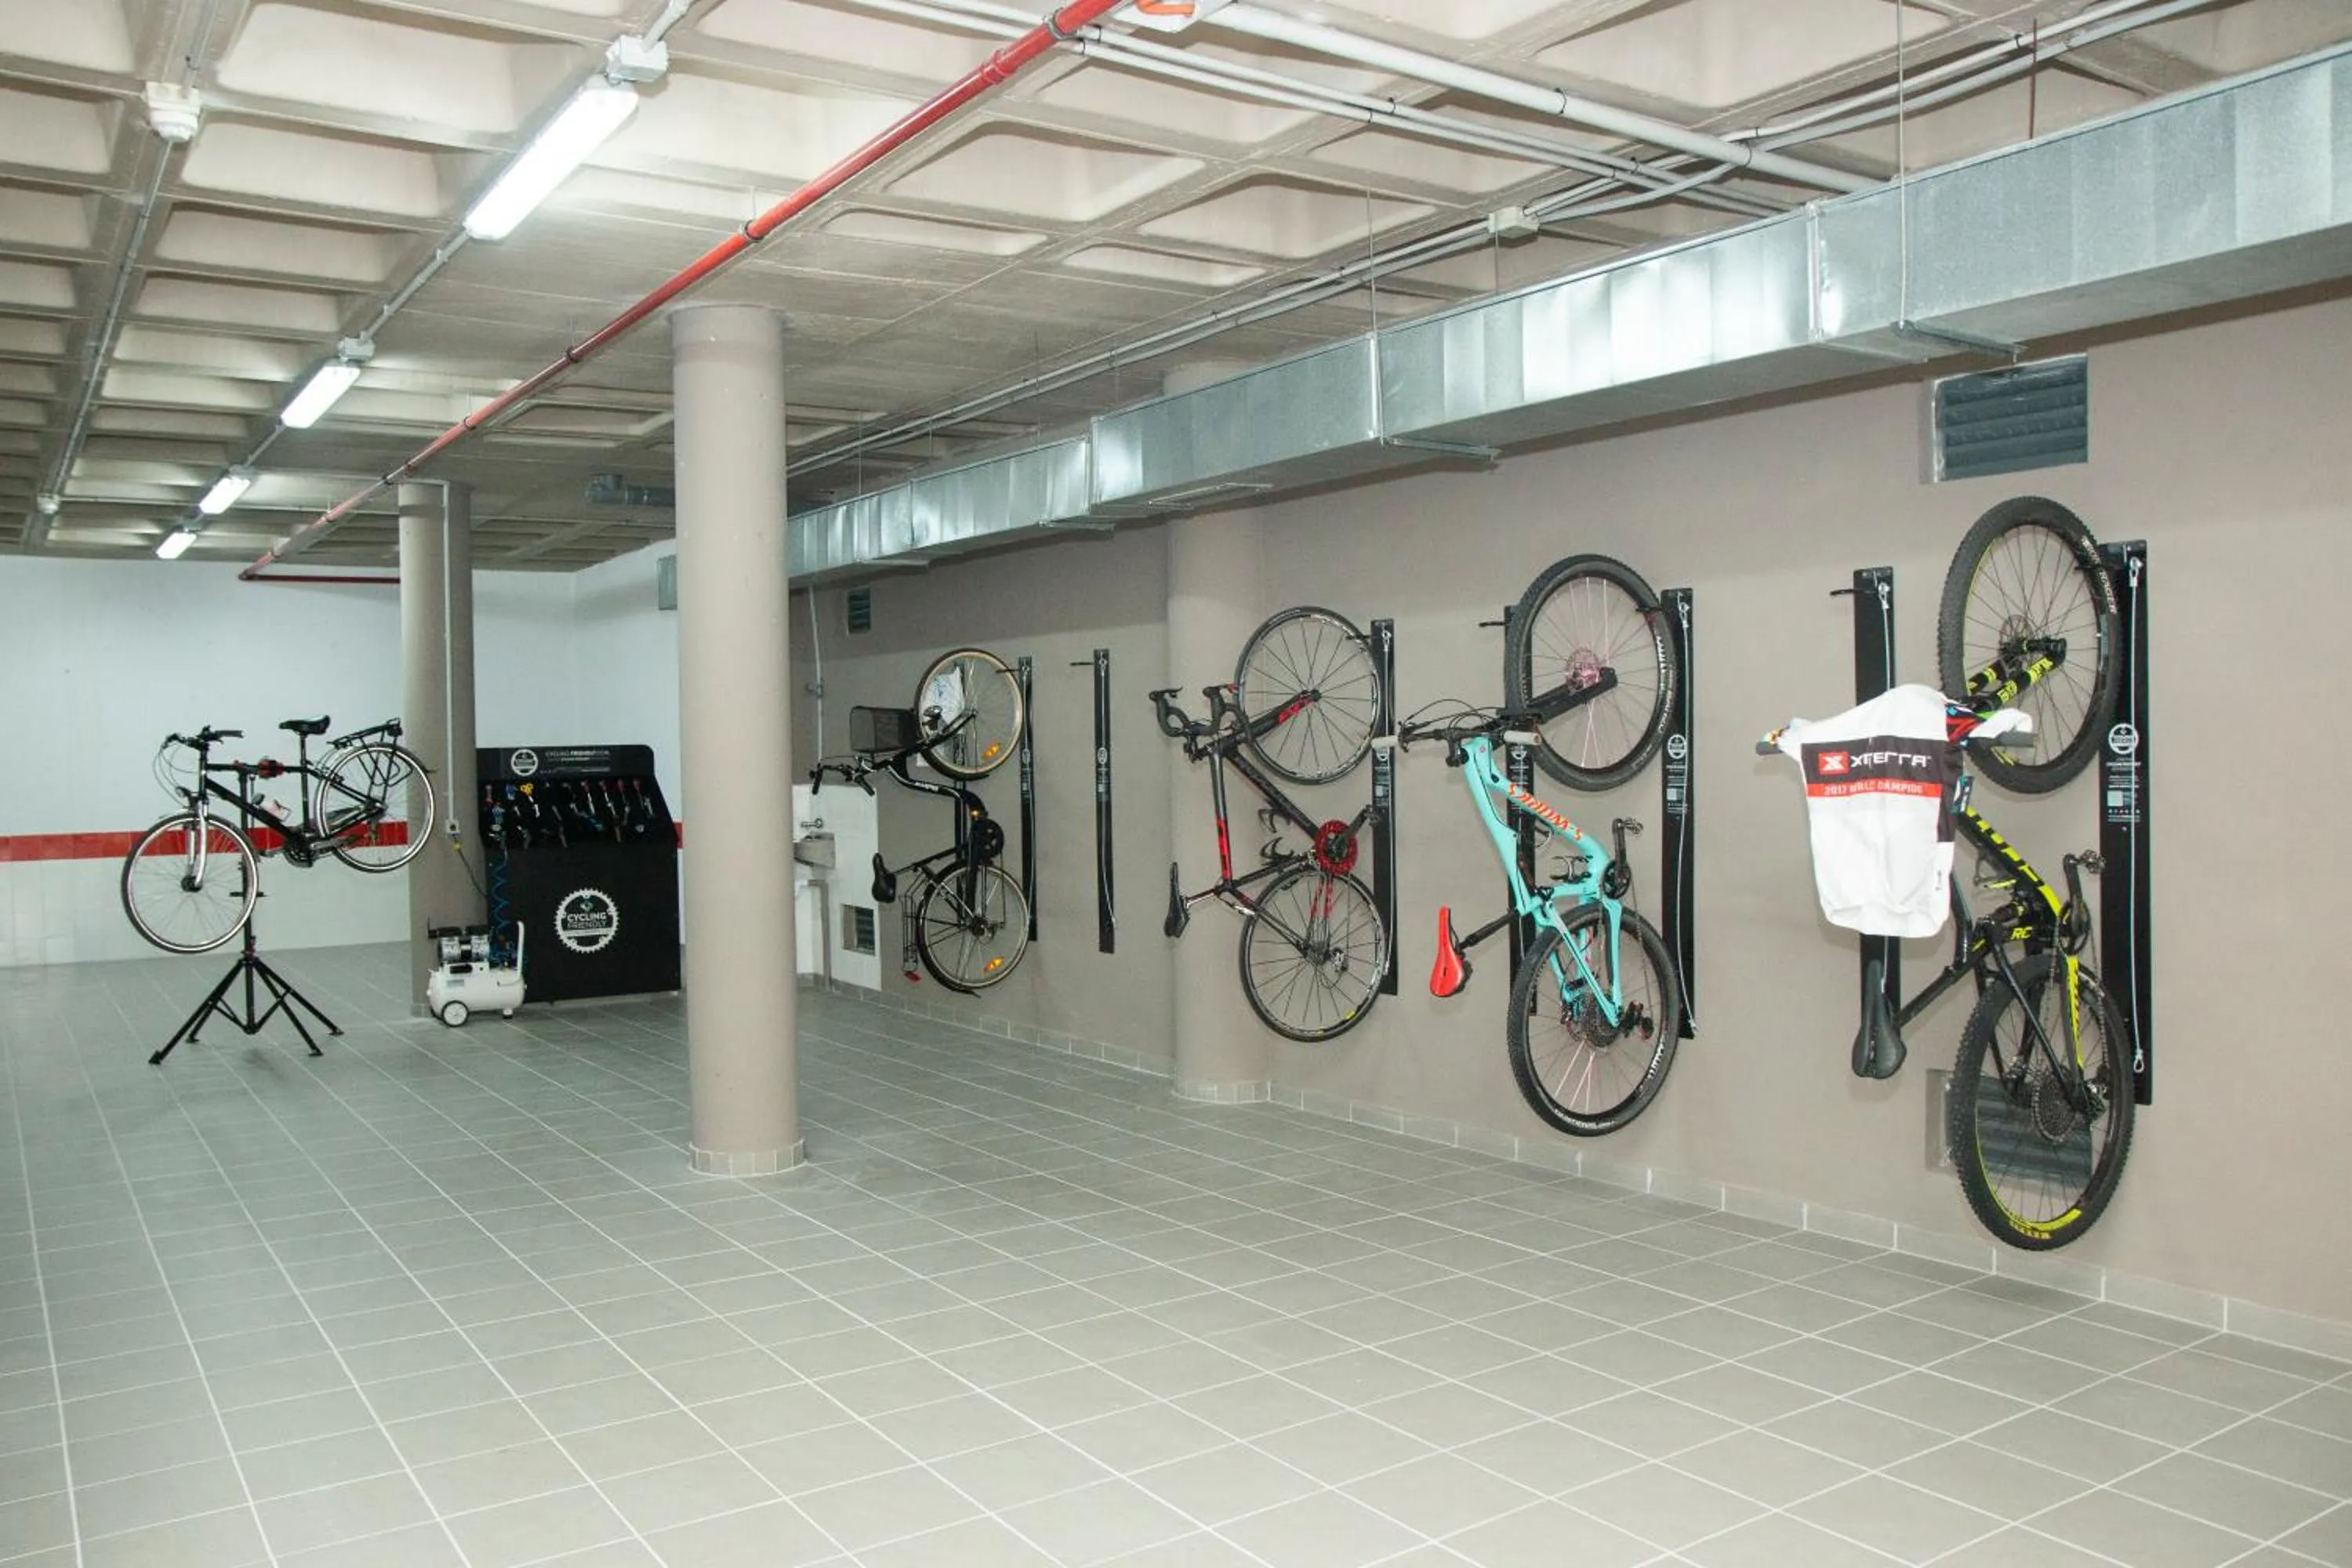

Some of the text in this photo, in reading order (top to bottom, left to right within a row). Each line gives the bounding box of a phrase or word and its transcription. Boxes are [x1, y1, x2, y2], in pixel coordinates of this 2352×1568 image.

[1850, 751, 1928, 768] XTERRA
[567, 912, 606, 922] CYCLING
[2009, 926, 2034, 940] RC
